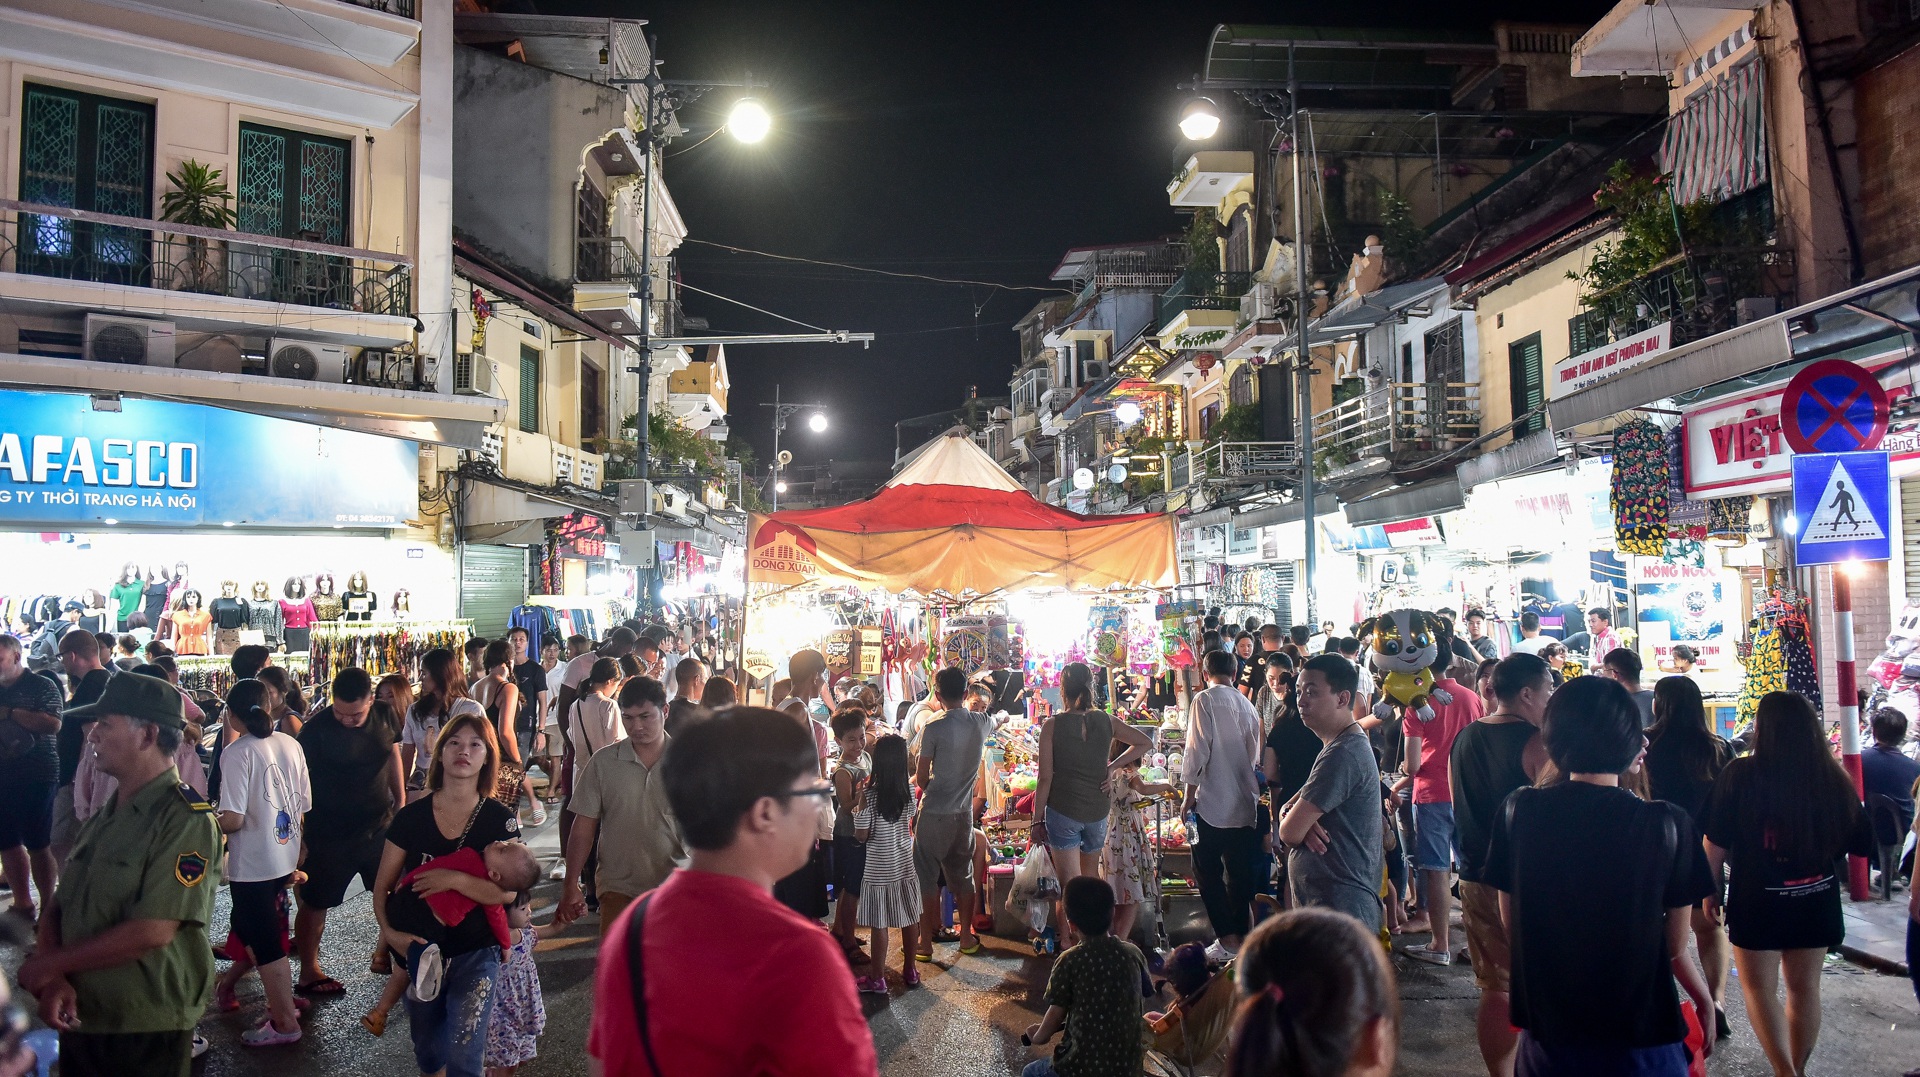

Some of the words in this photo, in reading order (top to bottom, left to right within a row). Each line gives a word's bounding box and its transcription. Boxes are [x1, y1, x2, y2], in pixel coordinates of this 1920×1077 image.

[1560, 366, 1578, 383] TRUNG
[1592, 356, 1604, 372] ANH
[1646, 335, 1660, 353] MAI
[1709, 408, 1783, 469] VIỆT
[1883, 437, 1914, 452] Hàng
[16, 491, 35, 504] TY
[42, 488, 79, 505] THỜI
[83, 493, 138, 507] TRANG
[141, 492, 164, 508] HÀ
[168, 494, 196, 511] NỘI
[753, 559, 785, 570] DONG
[788, 563, 816, 574] XUAN
[827, 655, 849, 667] Coffee
